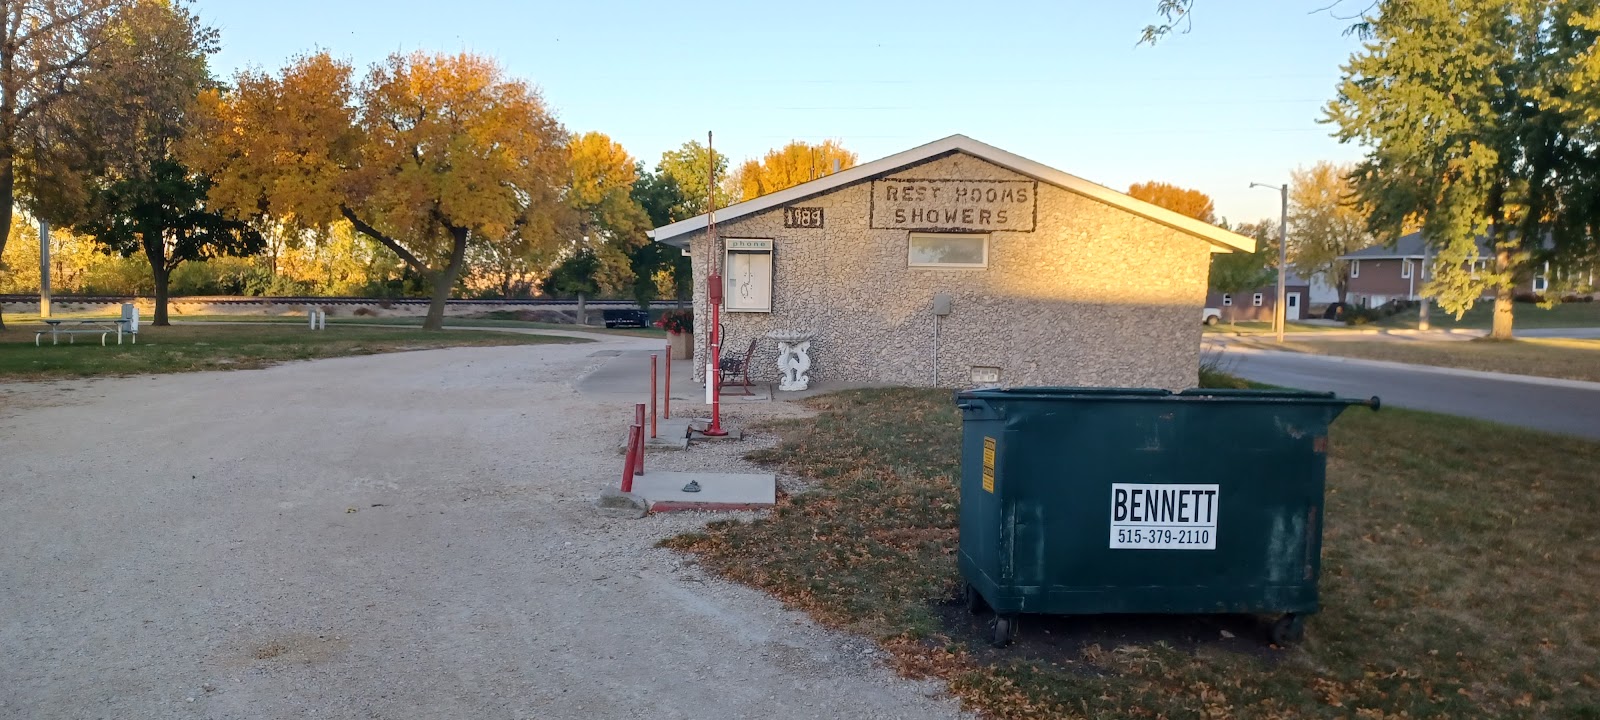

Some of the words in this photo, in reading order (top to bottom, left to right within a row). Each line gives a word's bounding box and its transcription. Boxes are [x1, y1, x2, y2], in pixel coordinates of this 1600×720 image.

[886, 185, 941, 202] REST
[955, 186, 1028, 204] ROOMS
[787, 209, 821, 226] 1989
[895, 208, 1009, 225] SHOWERS
[1114, 488, 1216, 522] BENNETT
[1118, 529, 1209, 544] 515-379-2110
